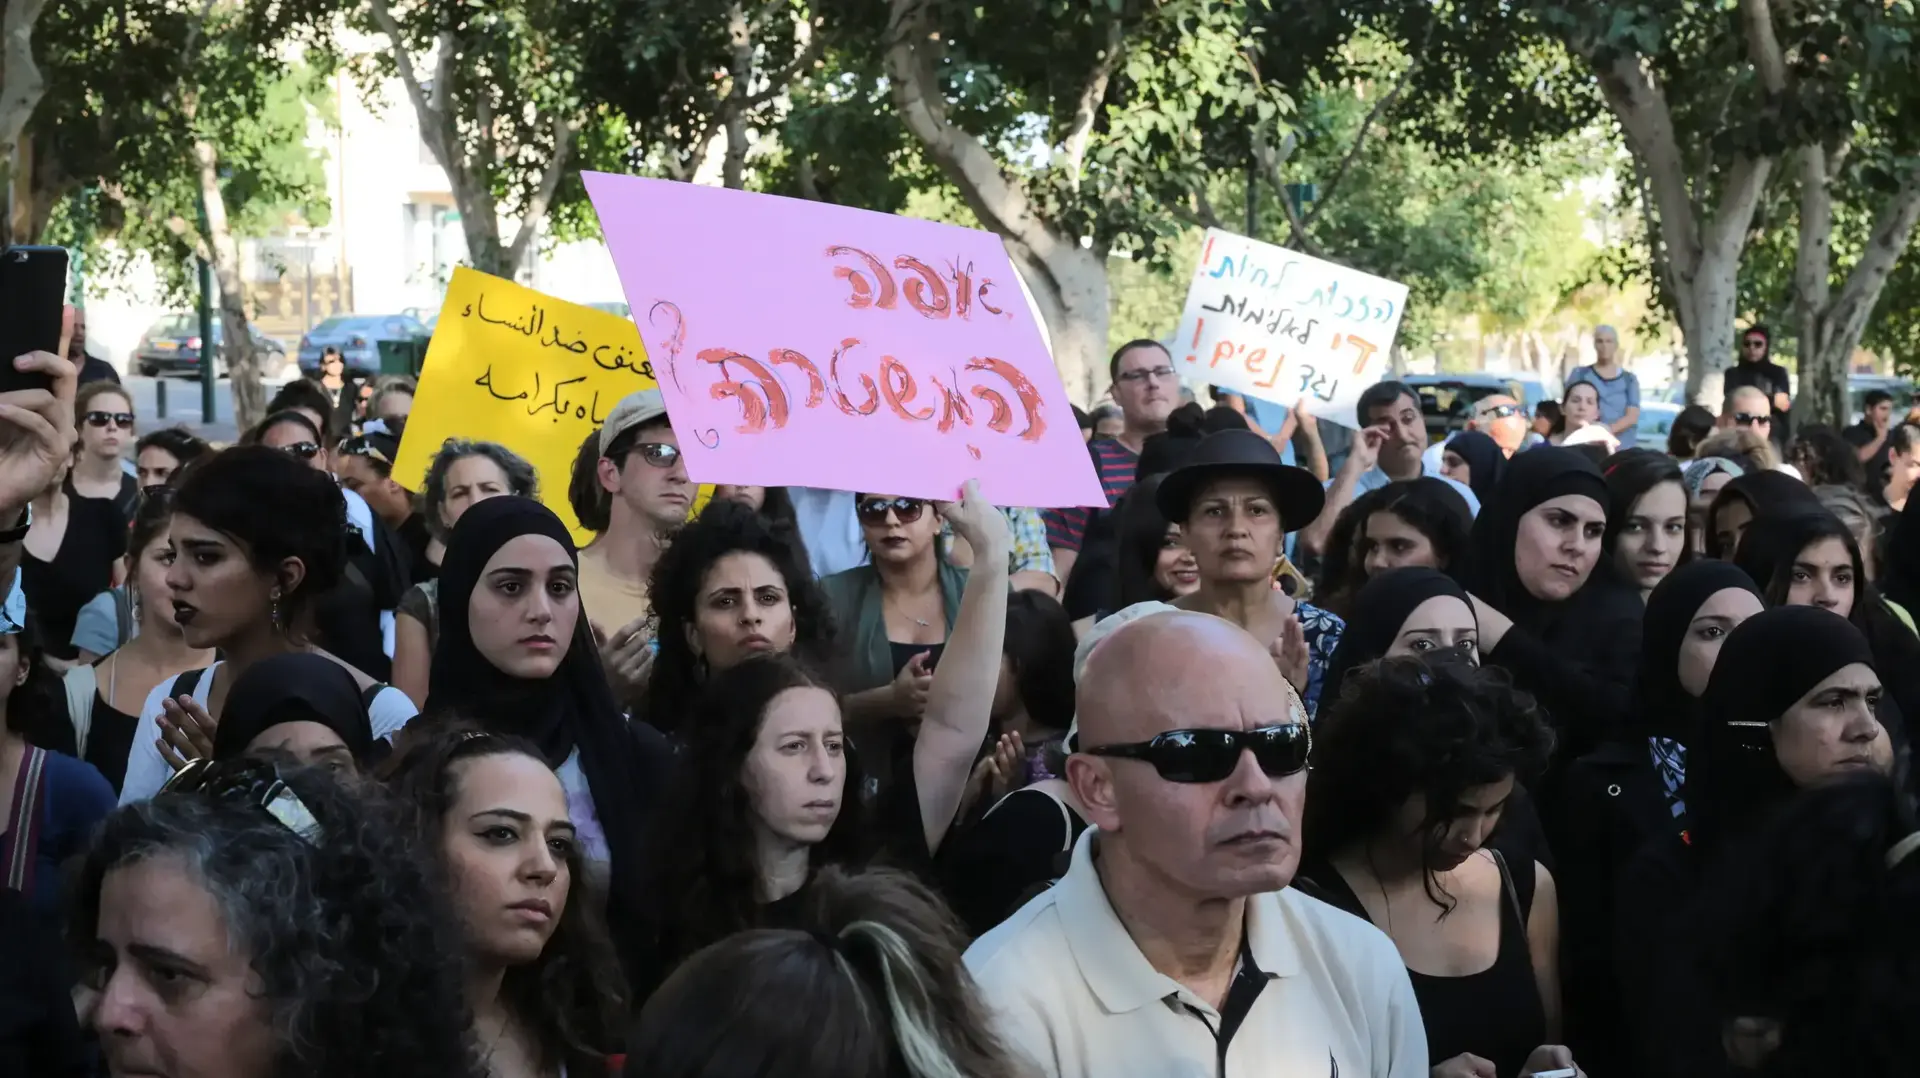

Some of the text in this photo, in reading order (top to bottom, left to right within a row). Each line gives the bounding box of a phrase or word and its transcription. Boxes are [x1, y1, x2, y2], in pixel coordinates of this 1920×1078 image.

[824, 245, 1008, 321] איפה
[460, 294, 544, 336] النساء
[1202, 294, 1378, 375] די לאלימות
[541, 325, 588, 354] ضد
[1299, 364, 1338, 402] נגד
